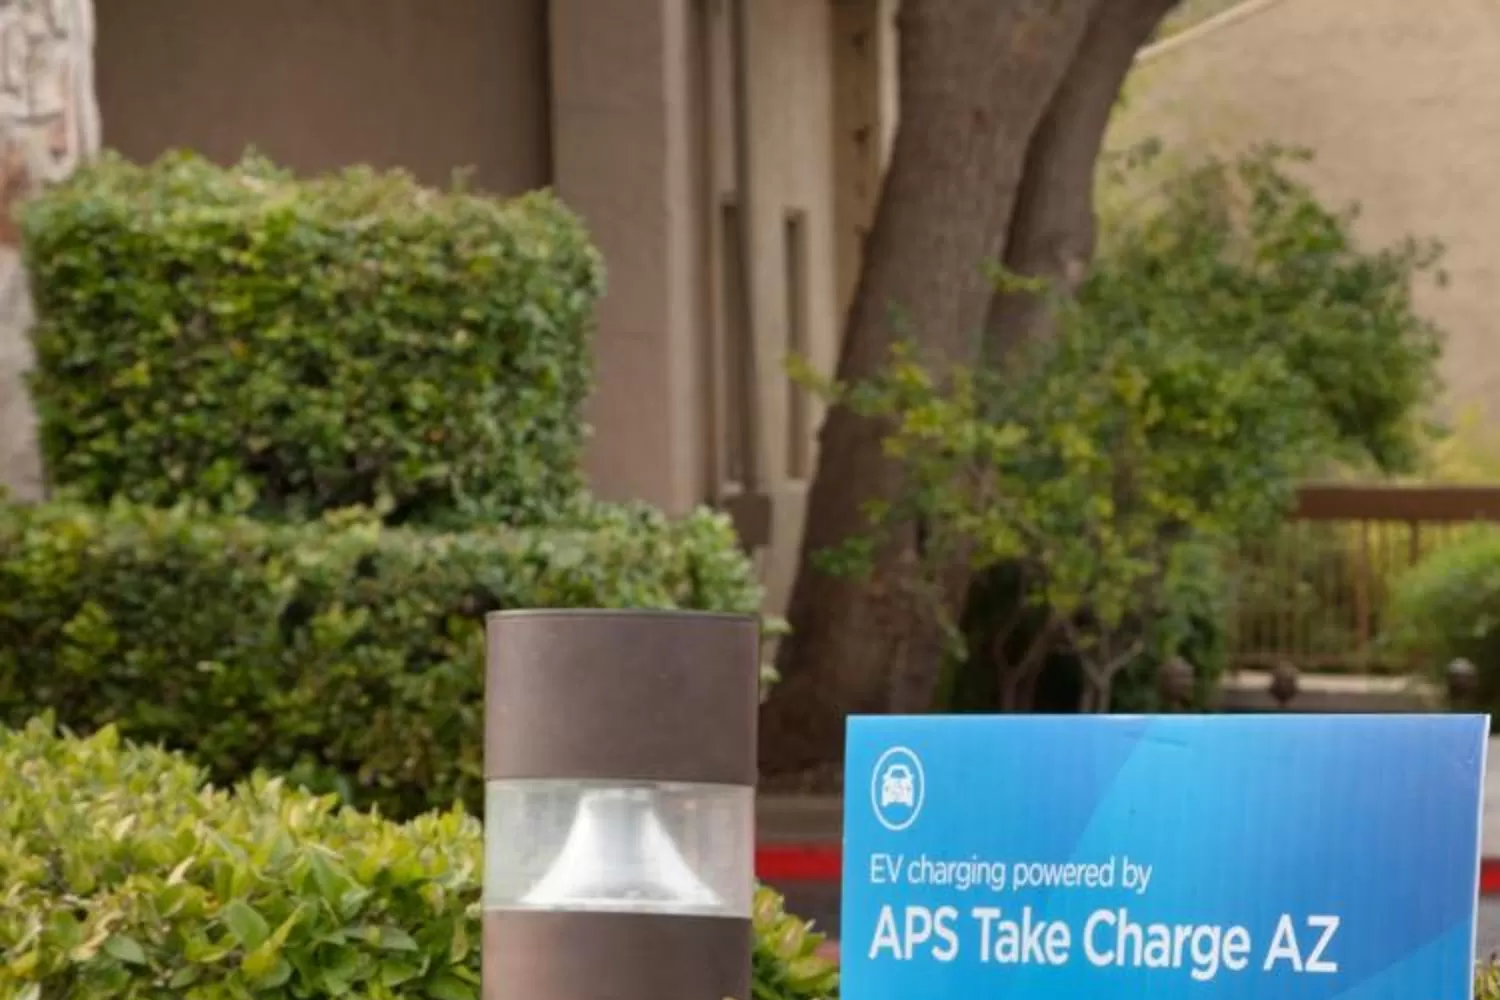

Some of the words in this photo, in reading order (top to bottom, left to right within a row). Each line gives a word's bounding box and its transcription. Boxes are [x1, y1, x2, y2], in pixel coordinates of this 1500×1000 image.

[869, 853, 904, 885] EV
[907, 854, 1006, 892] charging
[1013, 856, 1115, 891] powered
[1122, 856, 1153, 895] by
[868, 904, 960, 962] APS
[971, 905, 1071, 966] Take
[1083, 907, 1251, 981] Charge
[1262, 913, 1340, 973] AZ
